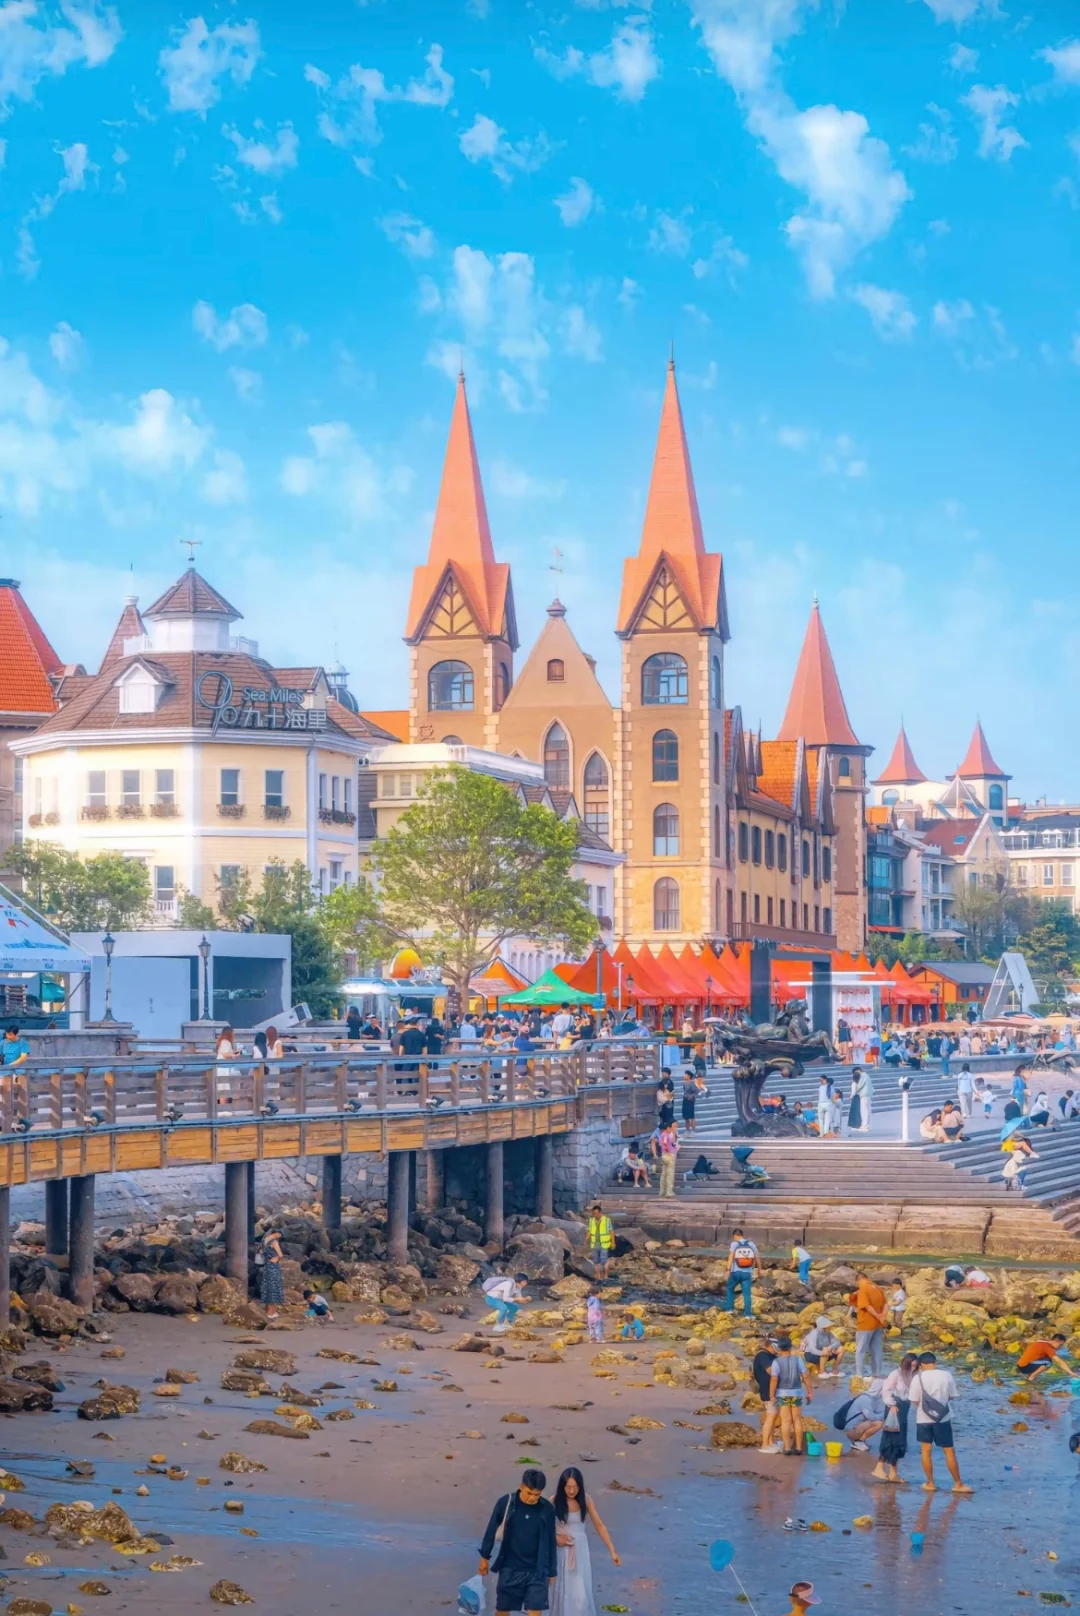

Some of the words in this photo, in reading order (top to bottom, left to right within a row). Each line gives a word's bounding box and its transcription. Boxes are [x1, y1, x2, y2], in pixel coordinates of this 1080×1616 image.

[243, 686, 266, 701] Sea
[243, 707, 327, 729] 九十海里
